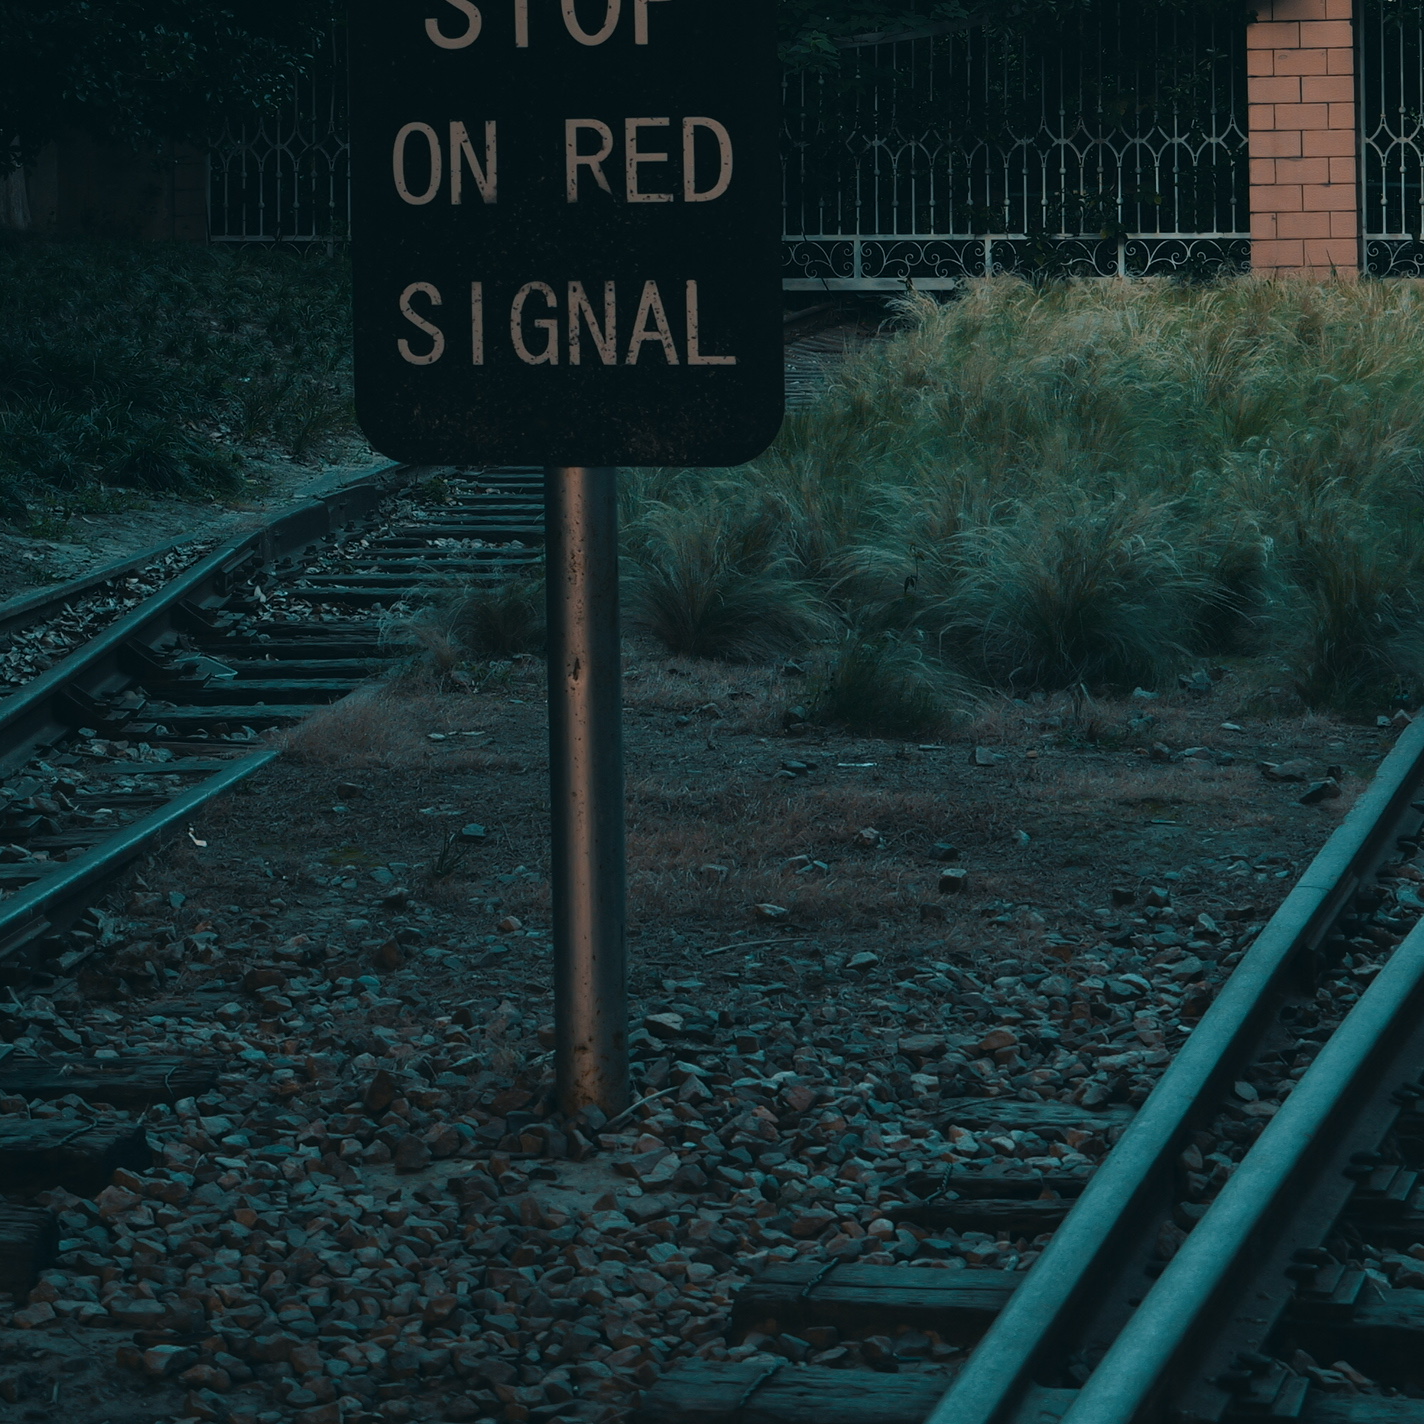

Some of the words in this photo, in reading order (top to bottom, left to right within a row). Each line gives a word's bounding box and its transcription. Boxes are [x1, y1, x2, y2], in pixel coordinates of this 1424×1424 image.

[392, 120, 498, 206] ON
[565, 116, 734, 204] RED
[396, 279, 737, 366] SIGNAL
